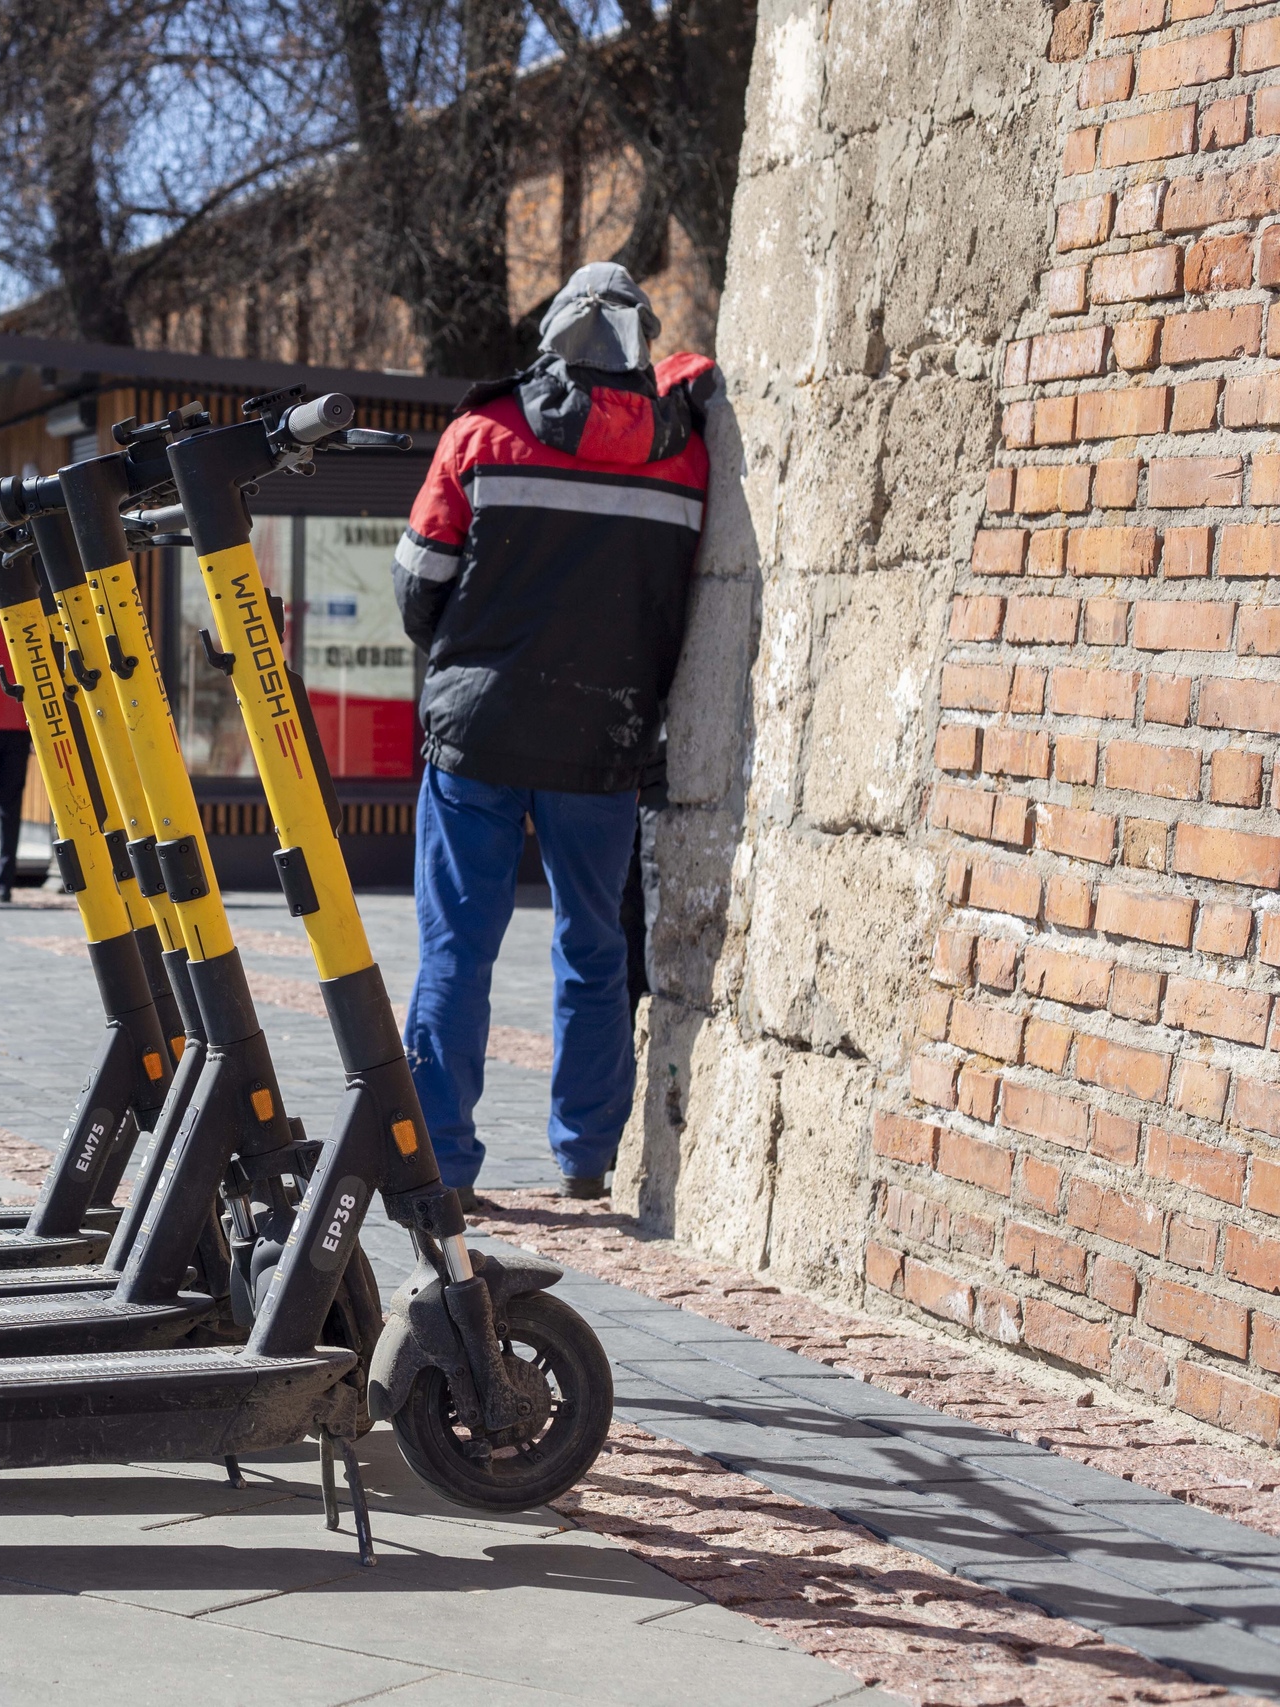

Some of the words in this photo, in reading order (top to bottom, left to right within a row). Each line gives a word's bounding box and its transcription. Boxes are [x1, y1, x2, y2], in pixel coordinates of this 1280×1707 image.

[22, 623, 67, 737] WHOOSH
[231, 573, 290, 718] WHOOSH
[75, 1123, 105, 1172] EM75
[322, 1194, 356, 1252] EP38
